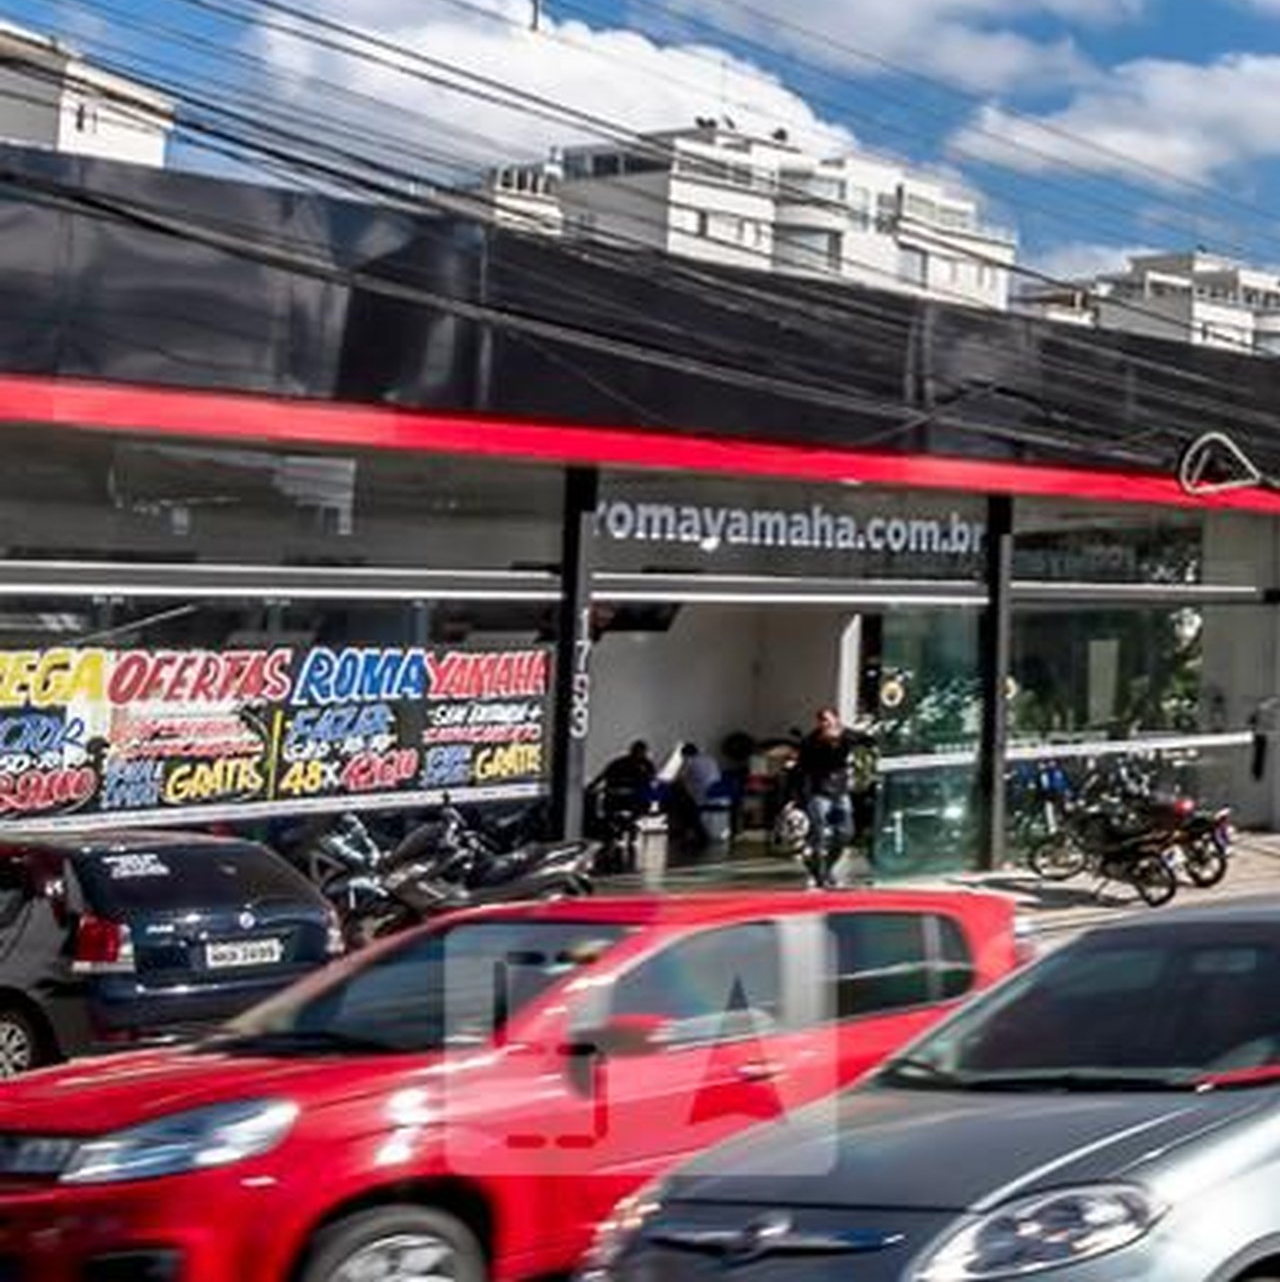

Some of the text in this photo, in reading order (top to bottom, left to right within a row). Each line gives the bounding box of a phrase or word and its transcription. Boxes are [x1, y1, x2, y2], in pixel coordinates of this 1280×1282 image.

[0, 646, 548, 707] EGA OFERTAS ROMA YAMAHA
